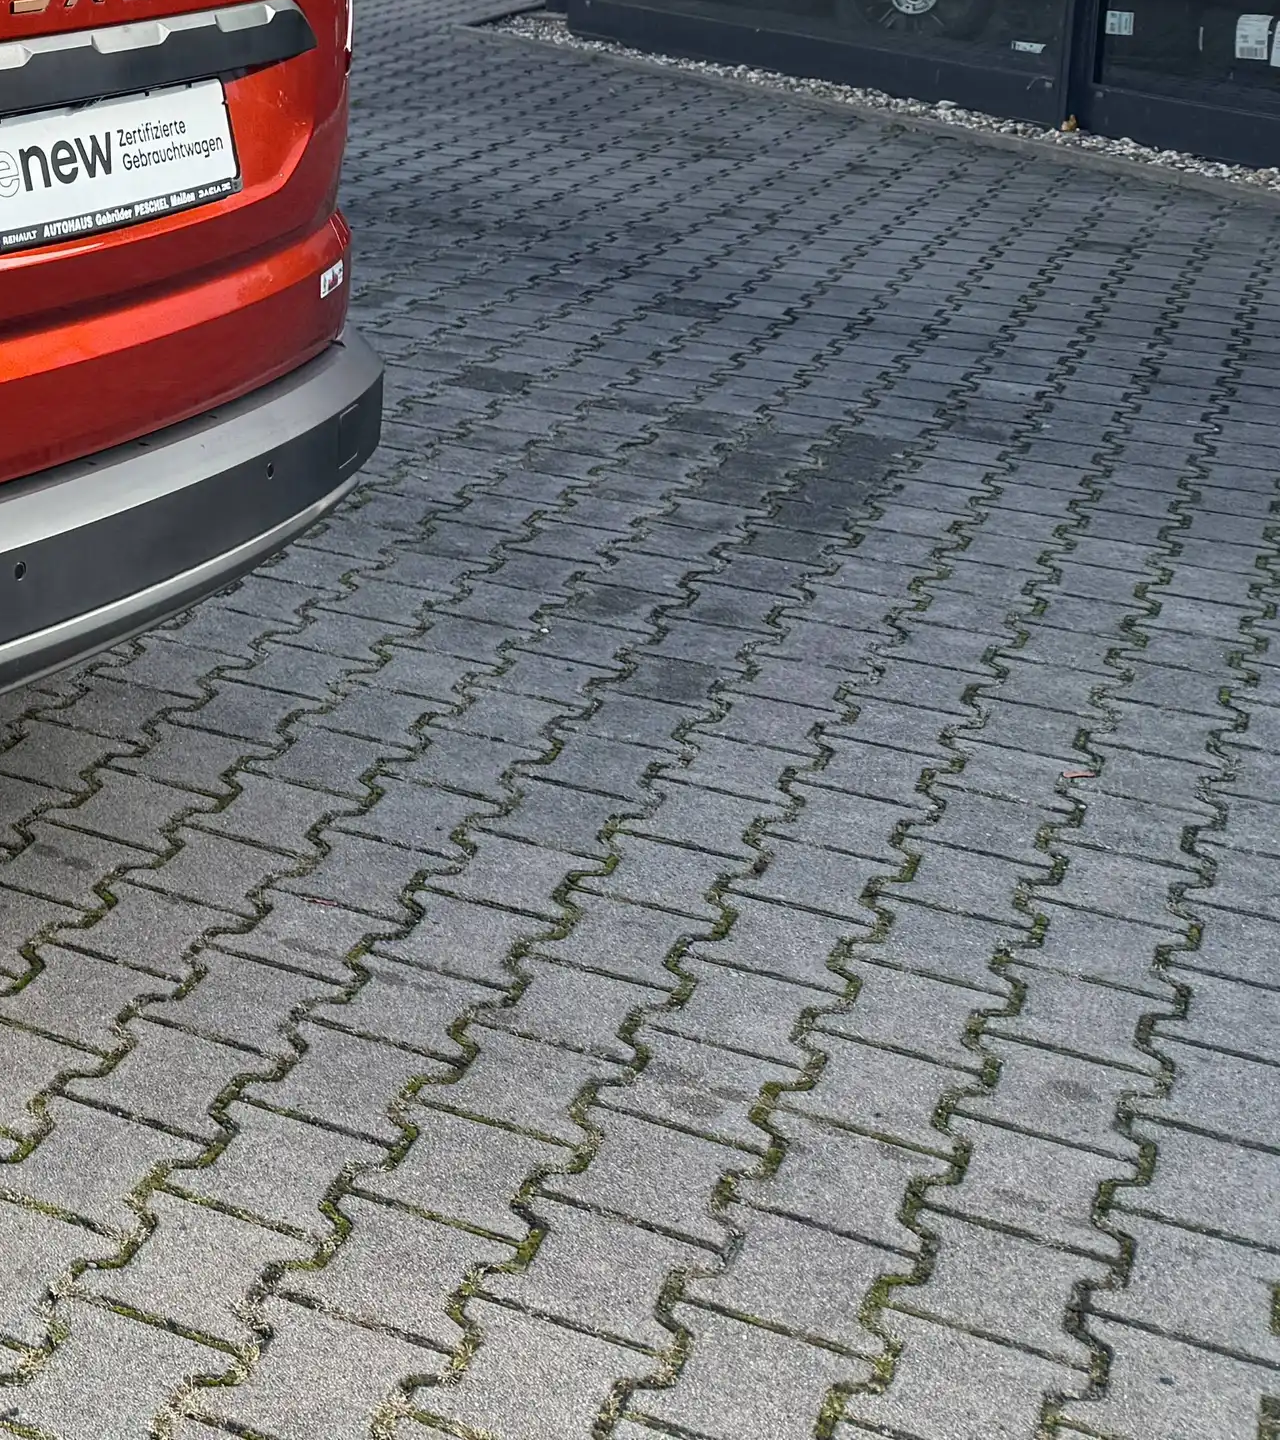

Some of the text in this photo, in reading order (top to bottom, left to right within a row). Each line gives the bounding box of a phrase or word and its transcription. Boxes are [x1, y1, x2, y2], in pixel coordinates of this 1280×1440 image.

[117, 120, 187, 147] Zertifizierte
[122, 136, 224, 171] Gebrauchtwagen
[3, 230, 38, 245] RENAULT
[43, 216, 93, 238] AUTOHAUS
[95, 208, 132, 226] Gebrüder
[134, 198, 169, 216] PESCHEL
